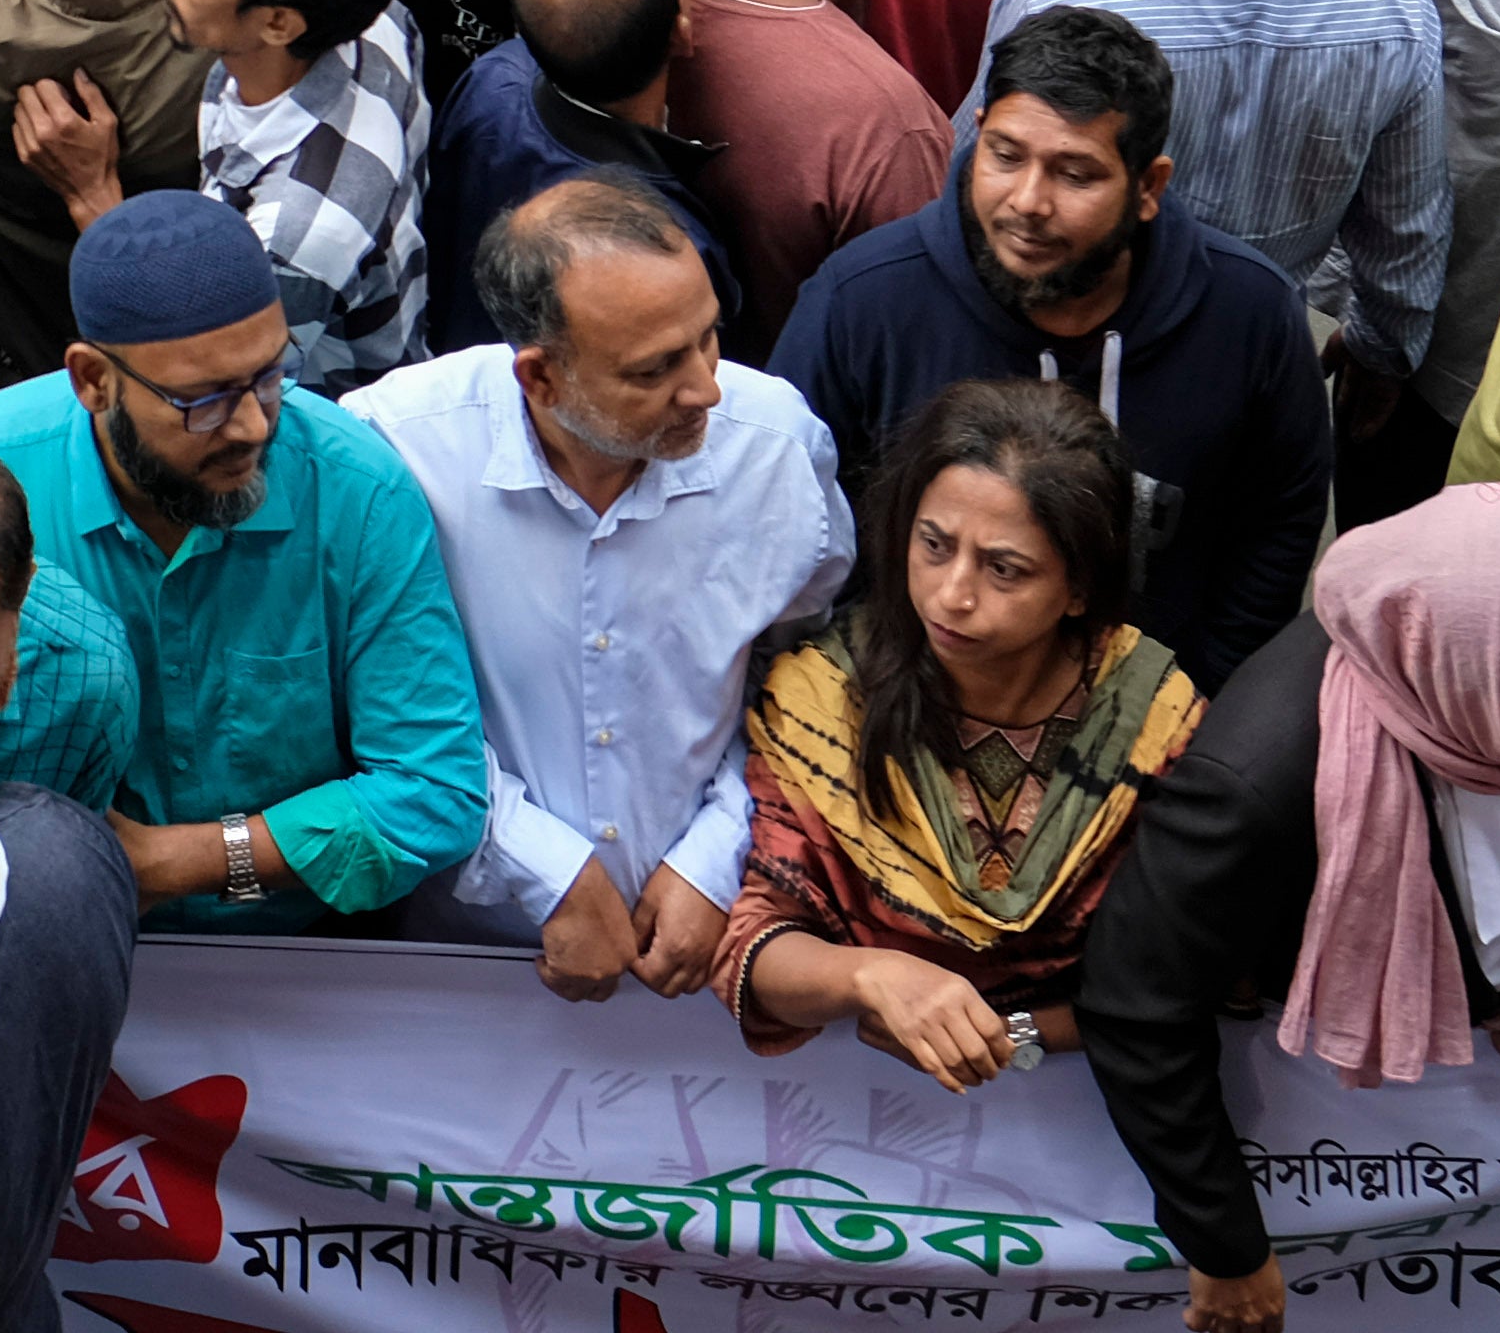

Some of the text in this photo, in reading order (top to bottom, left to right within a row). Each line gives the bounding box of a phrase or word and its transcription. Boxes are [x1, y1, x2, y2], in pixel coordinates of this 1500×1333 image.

[227, 1217, 672, 1293] মানবাধিকার
[699, 1269, 1004, 1320] লঙ্ঘনের
[255, 1154, 1062, 1277] আন্তর্জাতিক
